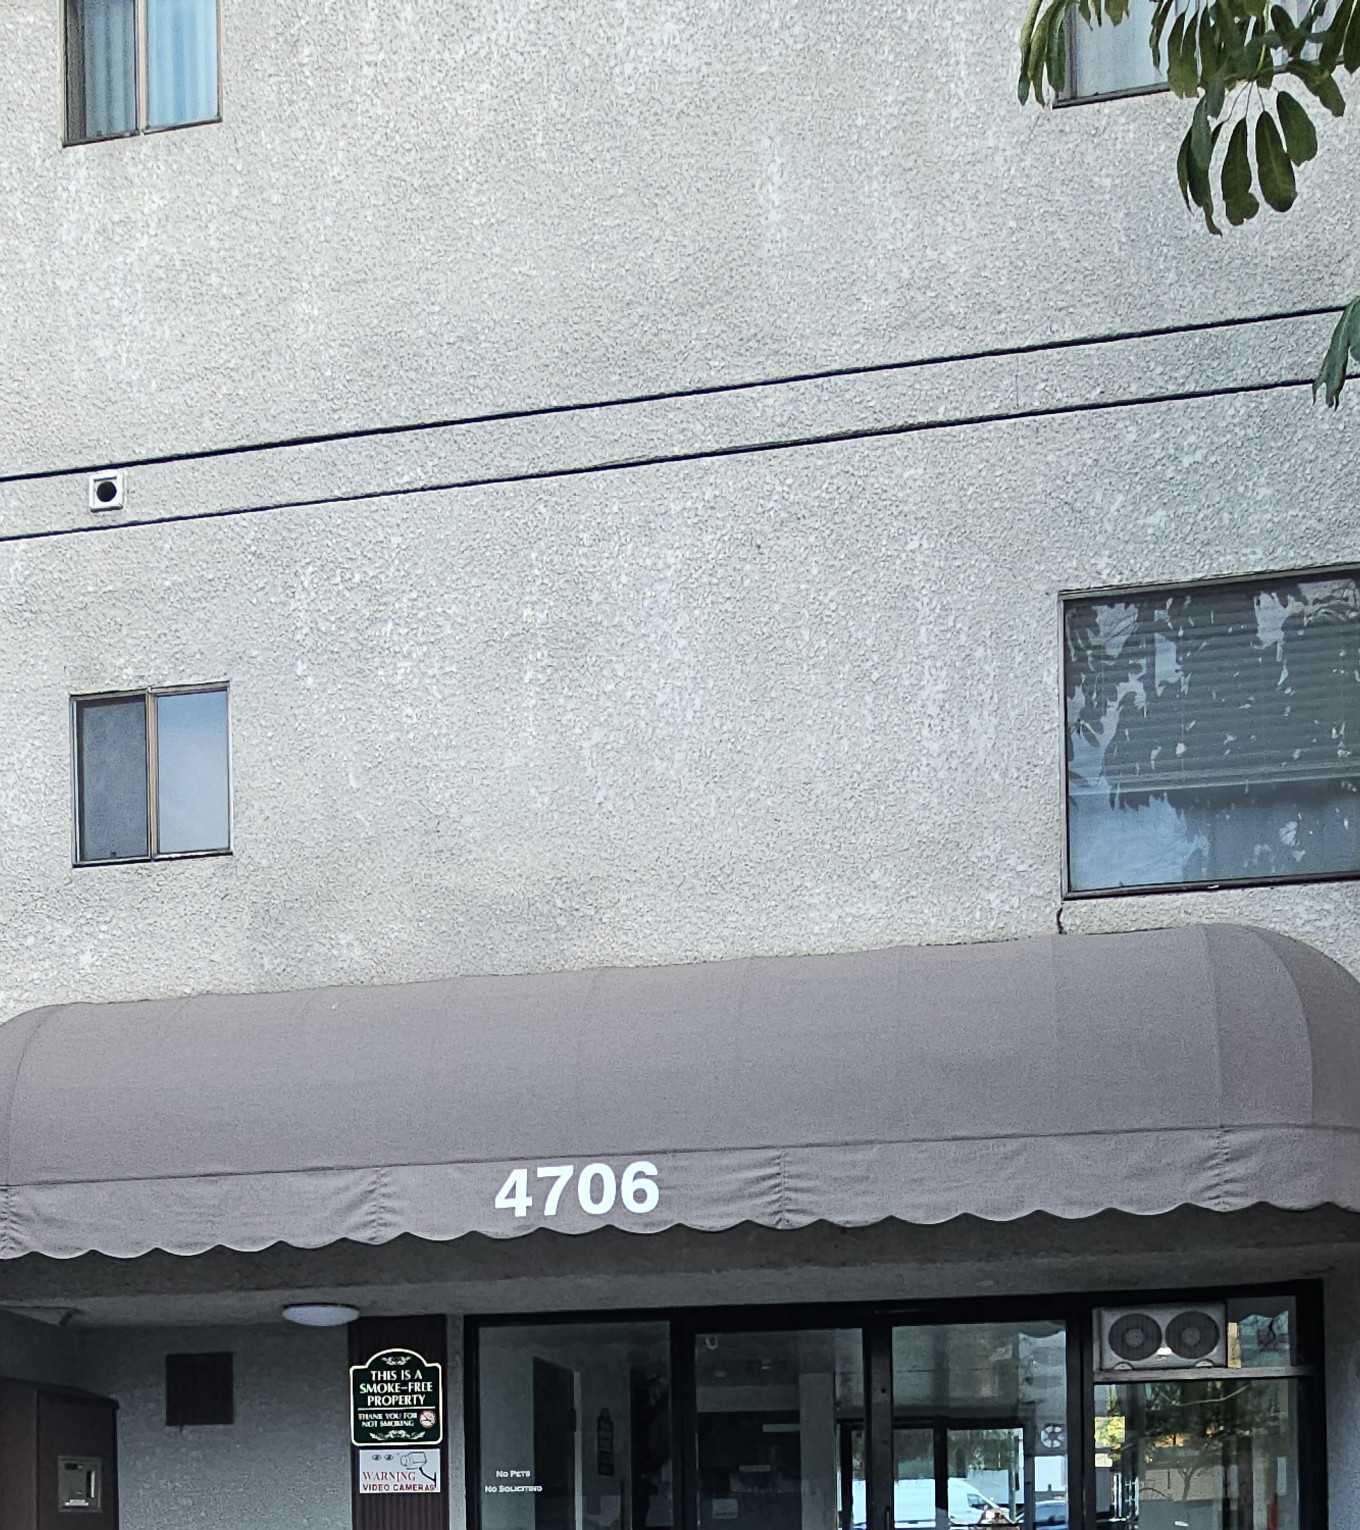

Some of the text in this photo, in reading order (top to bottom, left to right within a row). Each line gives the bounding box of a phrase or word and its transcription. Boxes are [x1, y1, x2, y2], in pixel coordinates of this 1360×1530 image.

[494, 1160, 660, 1218] 4706
[370, 1369, 423, 1381] THIS IS A
[359, 1381, 433, 1394] SMOKE-FREE
[367, 1394, 426, 1407] PROPERTY
[361, 1420, 378, 1428] NOT
[362, 1471, 416, 1482] WARNING
[362, 1482, 436, 1492] VIDEO CAMERAS
